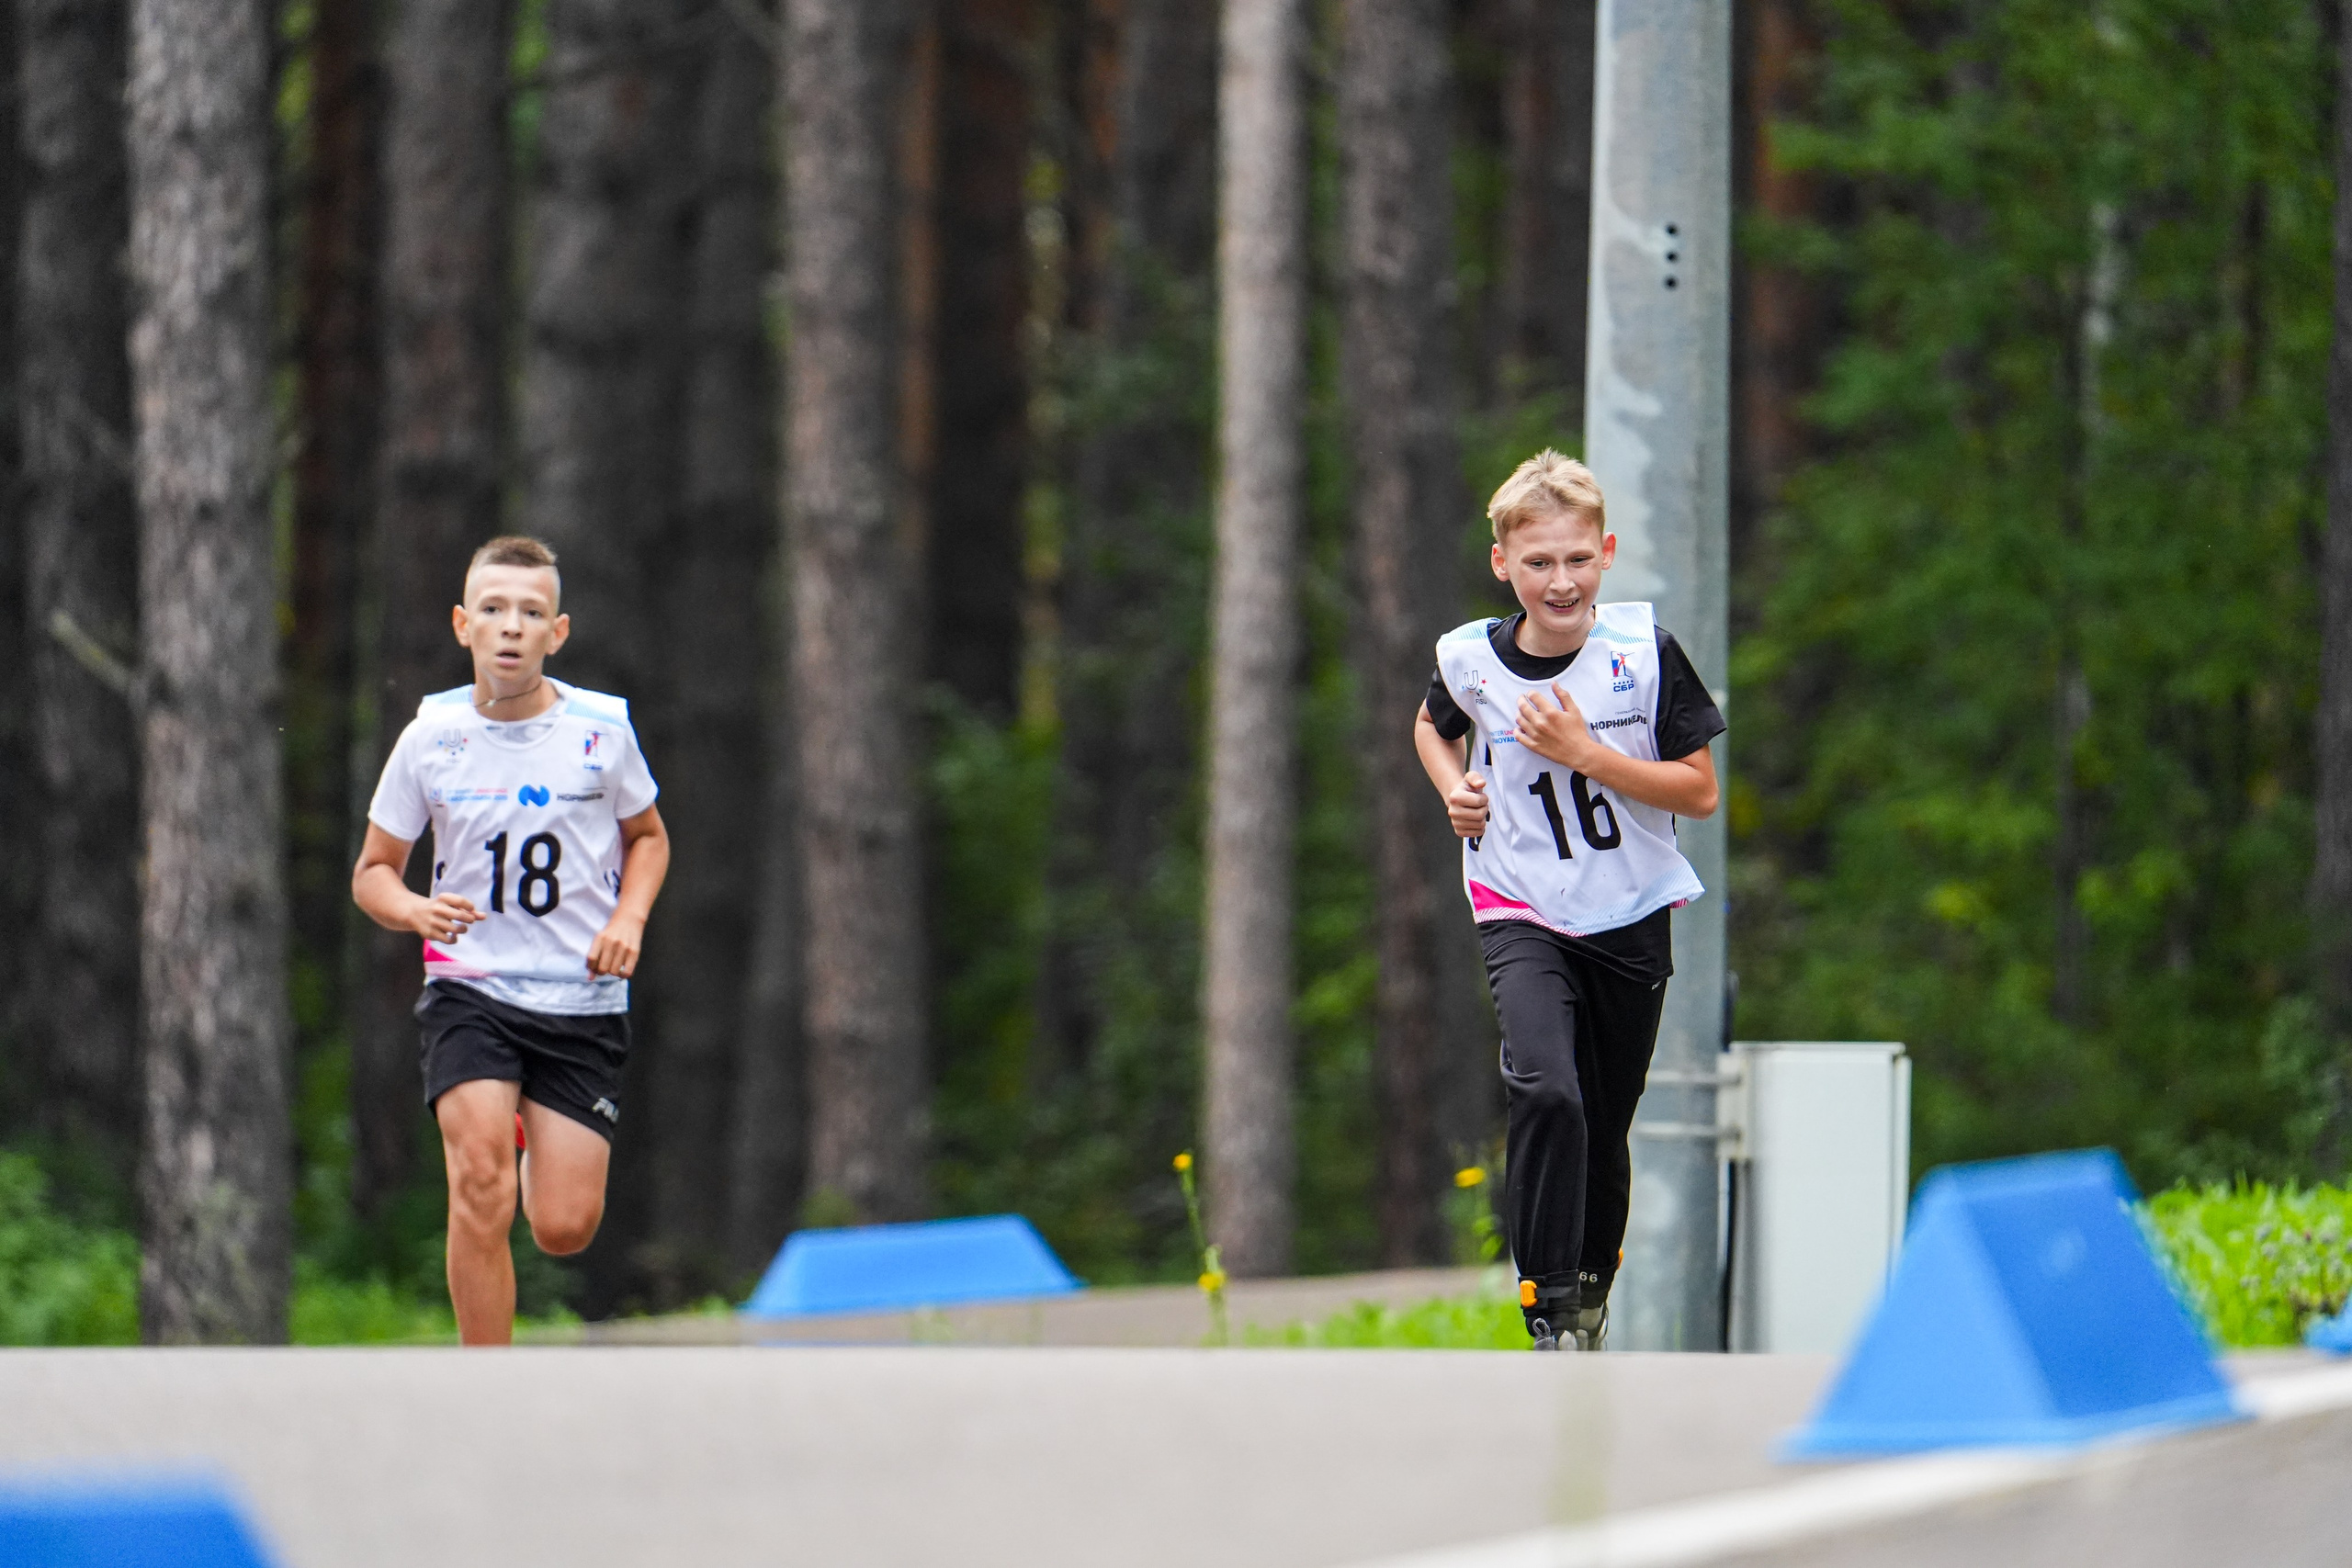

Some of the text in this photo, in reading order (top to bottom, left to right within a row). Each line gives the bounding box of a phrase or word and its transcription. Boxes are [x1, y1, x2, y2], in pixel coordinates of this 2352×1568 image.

[1613, 683, 1634, 692] СБР
[1528, 770, 1622, 860] 16
[484, 830, 561, 917] 18
[1579, 1271, 1598, 1282] 66
